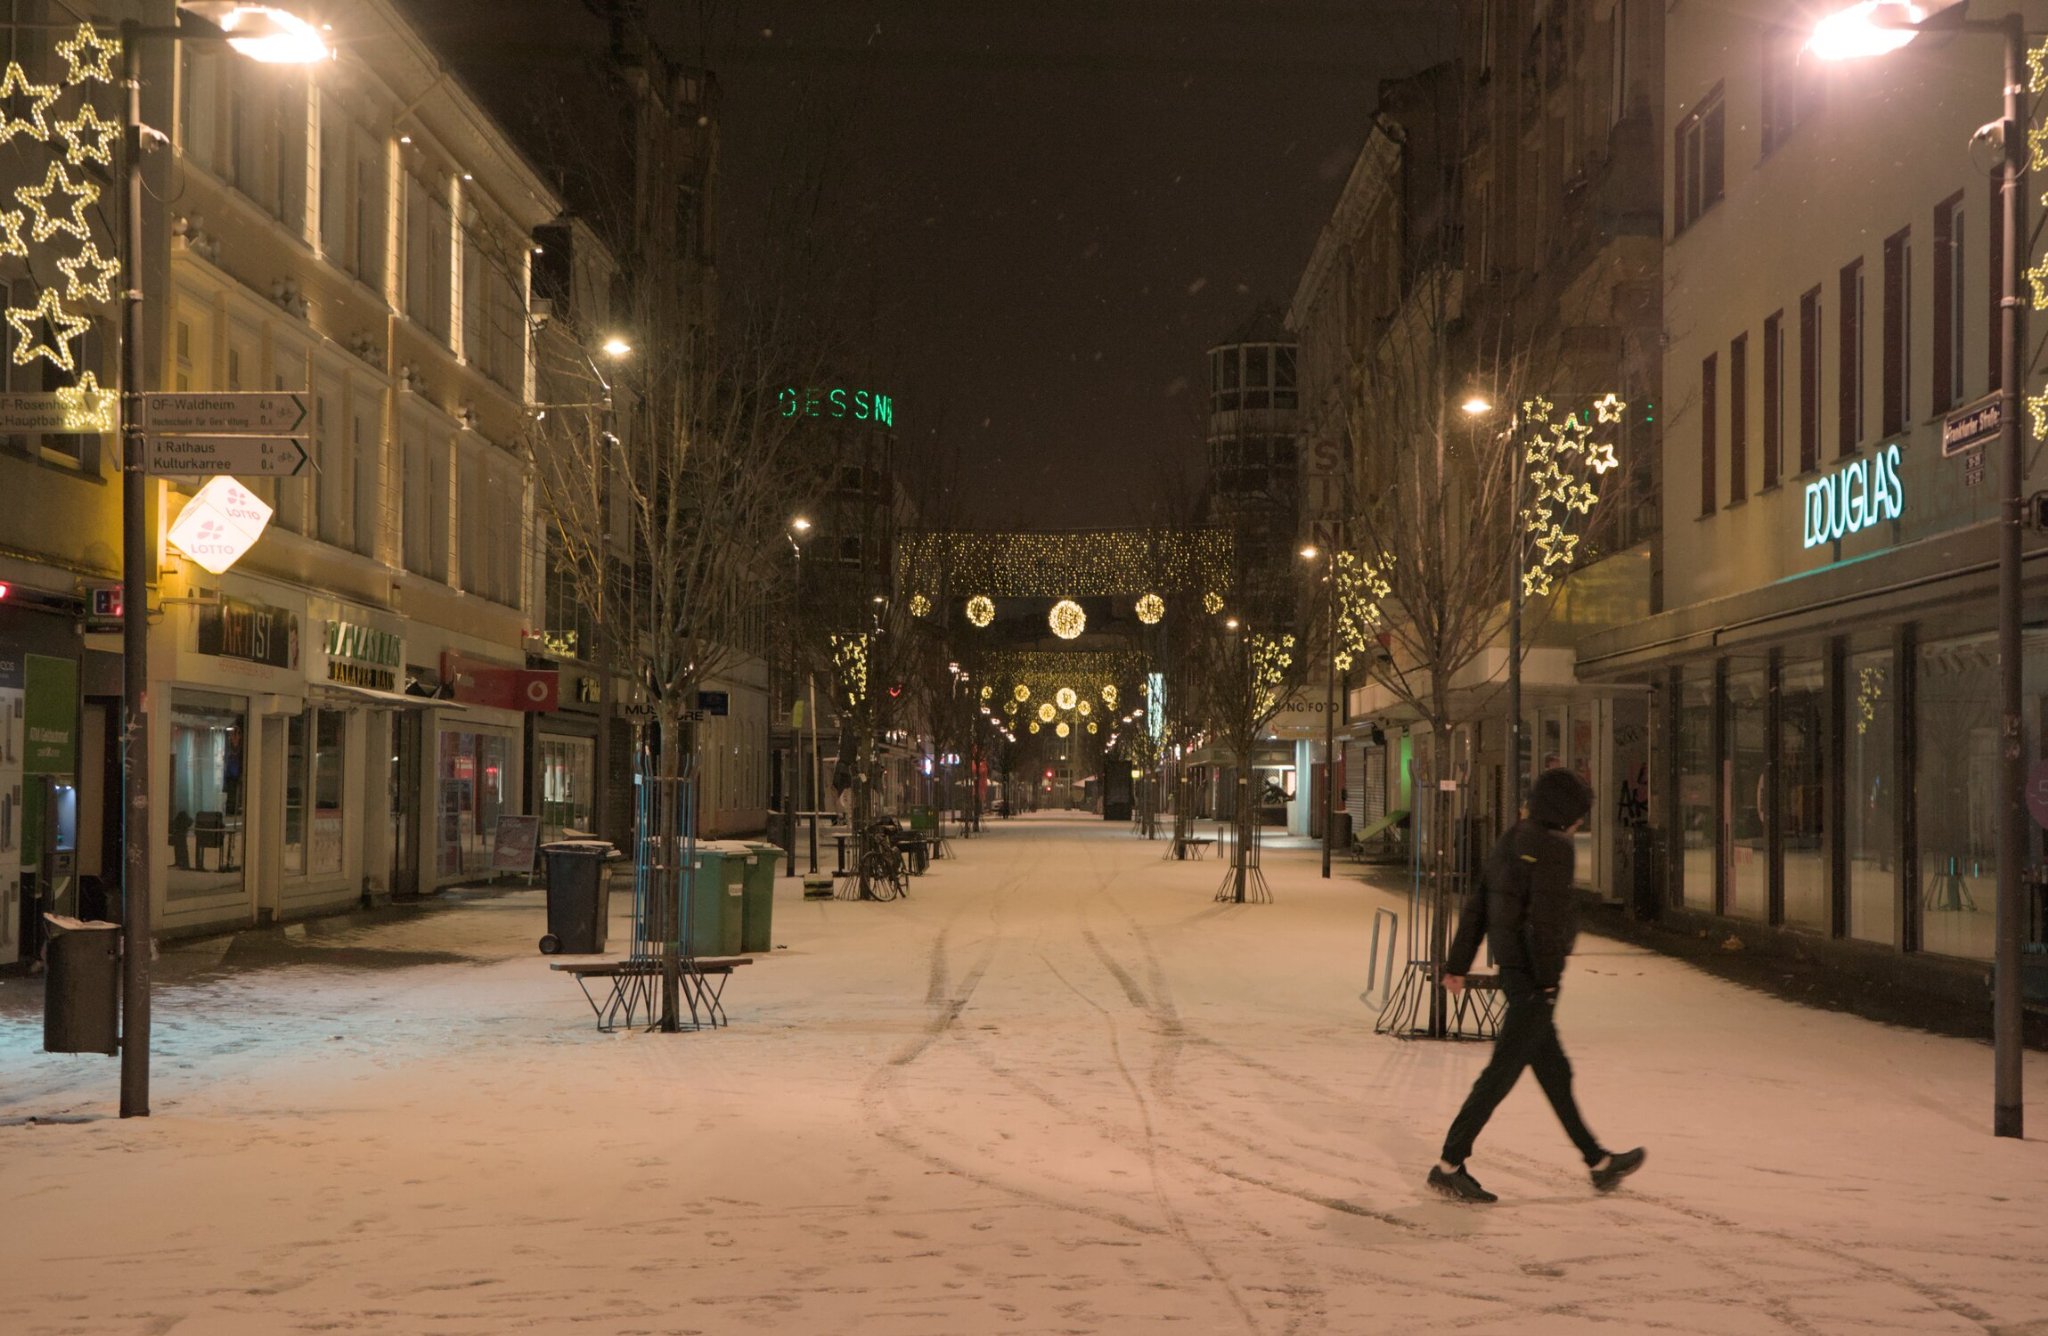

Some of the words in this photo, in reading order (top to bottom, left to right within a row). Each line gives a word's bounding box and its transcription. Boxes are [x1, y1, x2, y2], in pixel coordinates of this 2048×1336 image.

[166, 442, 215, 452] Rathaus
[154, 459, 231, 469] Kulturkarree
[1804, 445, 1903, 549] DOUGLAS
[225, 507, 262, 520] LOTTO
[191, 544, 235, 555] LOTTO
